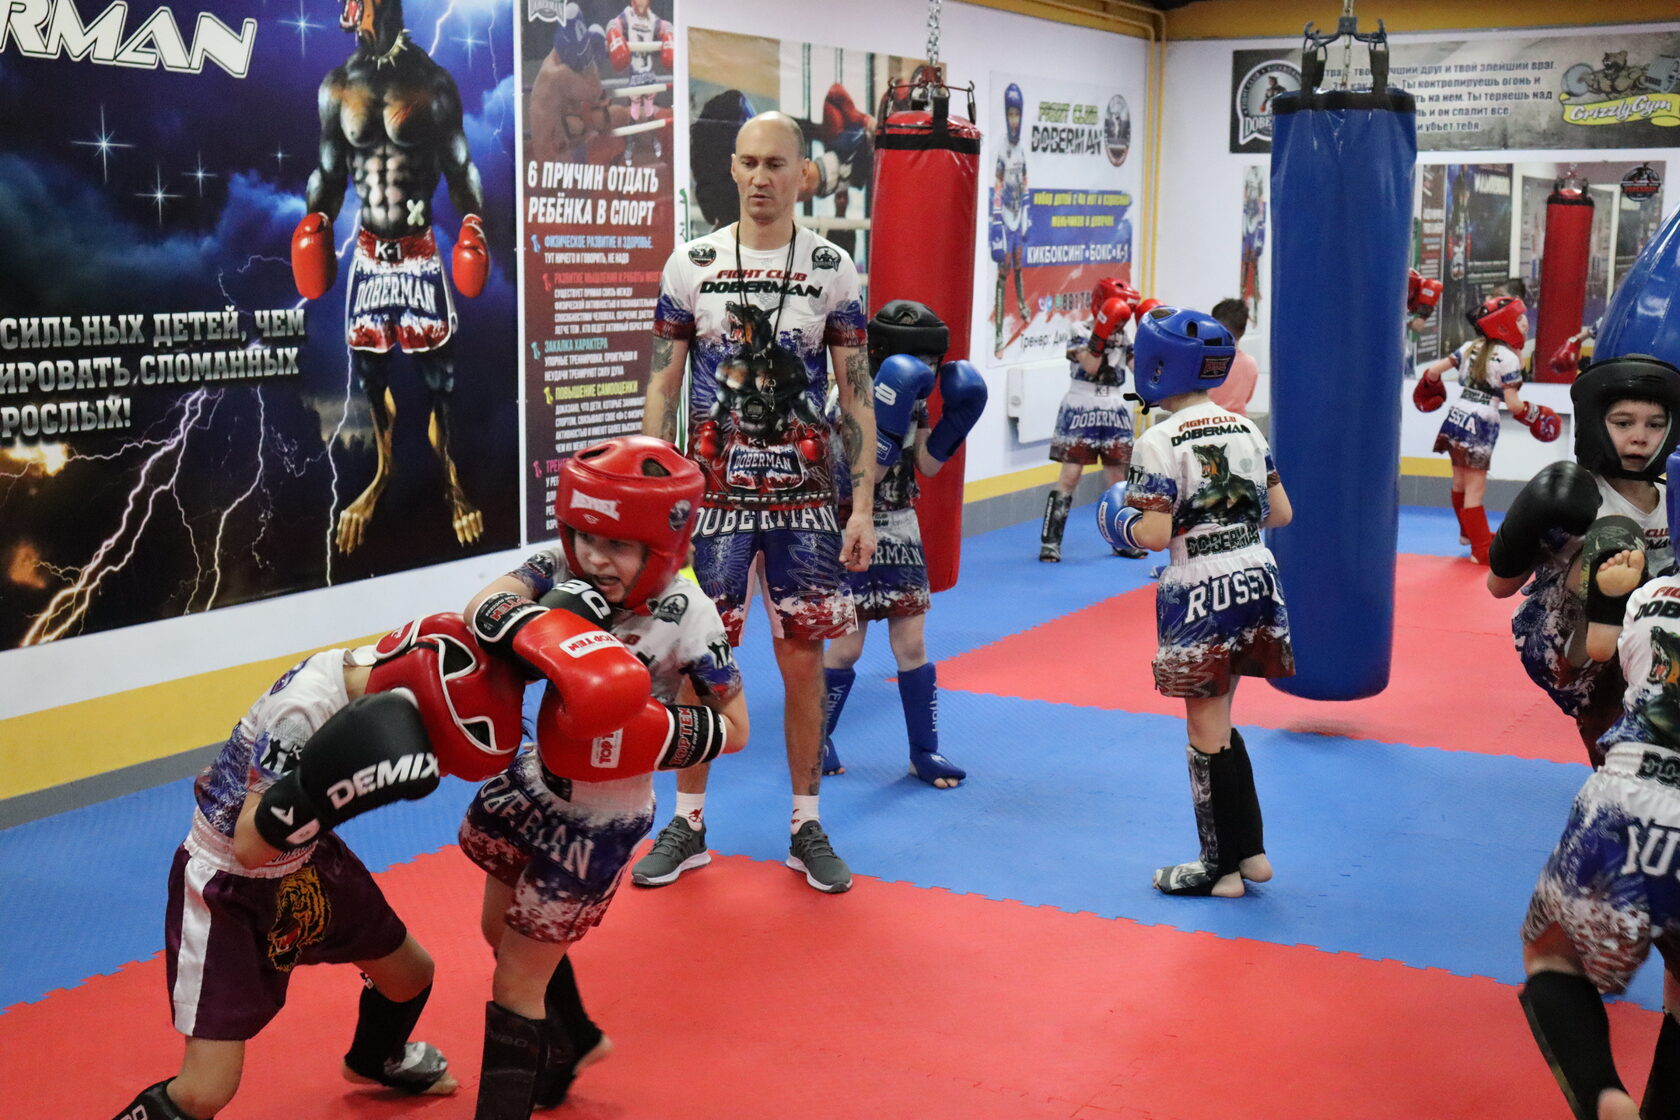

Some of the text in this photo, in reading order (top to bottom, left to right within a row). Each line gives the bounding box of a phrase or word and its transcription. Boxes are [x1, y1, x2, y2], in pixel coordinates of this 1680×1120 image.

[0, 0, 257, 78] RMAN
[1418, 78, 1500, 89] контролируешь
[1502, 77, 1531, 86] огонь
[1484, 91, 1530, 102] теряешь
[1532, 91, 1553, 100] над
[1031, 125, 1103, 155] DOBERMAN
[528, 160, 659, 194] 6 ПРИЧИН ОТДАТЬ
[528, 192, 655, 225] РЕБЁНКА В СПОРТ
[375, 240, 402, 260] K-1
[1027, 246, 1084, 264] КИКБОКСИНГ
[716, 269, 808, 282] FIGHT CLUB
[353, 273, 437, 316] DOBERMAN
[700, 280, 823, 298] DOBERMAN
[0, 305, 306, 349] СИЛЬНЫХ ДЕТЕЙ, ЧЕМ
[0, 347, 300, 395] ИРОВАТЬ СЛОМАННЫХ
[0, 398, 132, 438] РОСЛЫХ!
[1069, 410, 1132, 430] DOBERMAN
[1178, 416, 1212, 432] FIGHT
[748, 437, 767, 446] K-1
[1171, 424, 1252, 447] DOBERMAN
[733, 453, 792, 470] DOBERMAN
[326, 751, 441, 810] DEMIX
